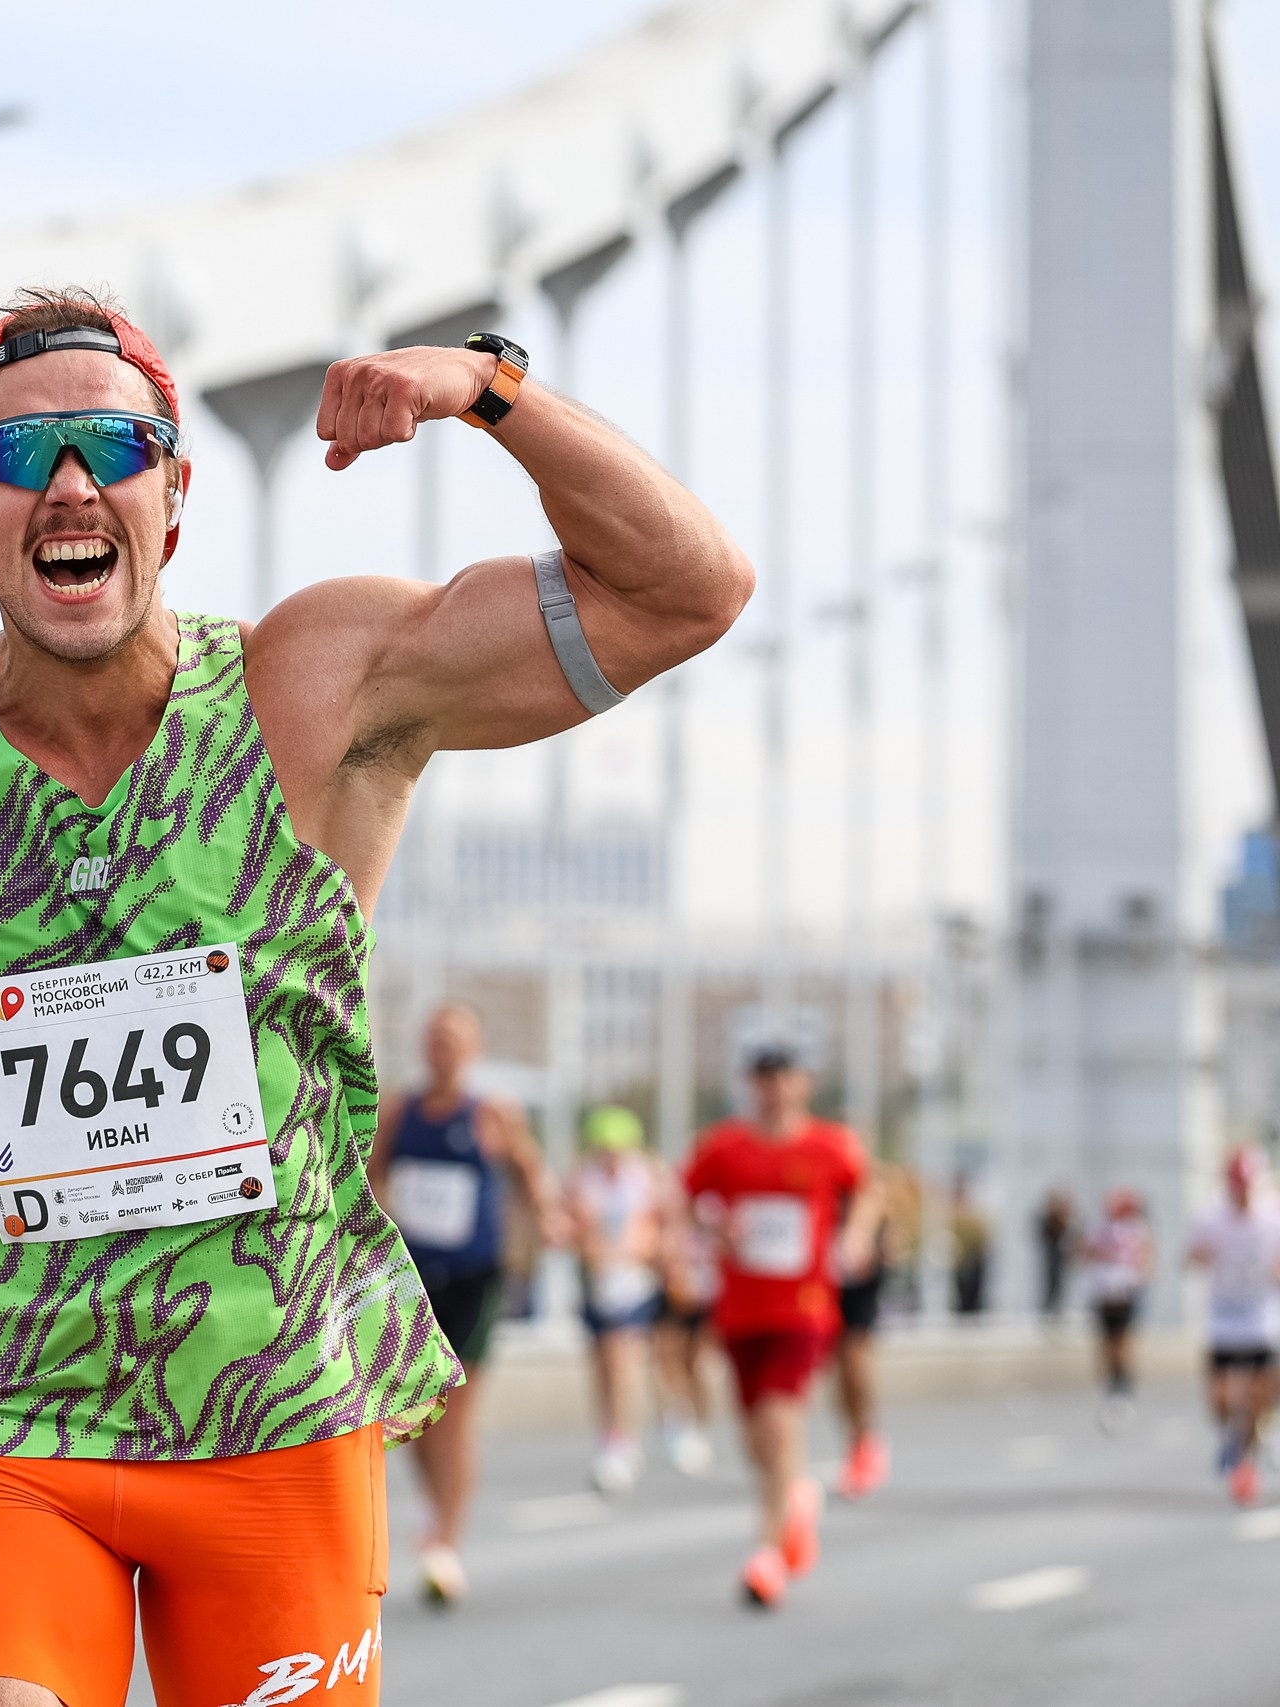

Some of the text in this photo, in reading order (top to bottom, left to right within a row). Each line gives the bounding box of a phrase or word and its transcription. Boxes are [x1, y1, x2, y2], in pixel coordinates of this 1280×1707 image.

[143, 960, 201, 980] 42,2 КМ
[30, 973, 101, 991] СБЕРПРАЙМ
[32, 978, 129, 1004] МОСКОВСКИЙ
[155, 982, 197, 999] 2026
[34, 997, 105, 1017] МАРАФОН
[0, 1022, 211, 1127] 7649
[232, 1112, 241, 1125] 1
[87, 1123, 150, 1150] ИВАН
[125, 1172, 163, 1186] МОСКОВСКИЙ
[189, 1166, 238, 1181] СБЕР Прайм
[126, 1185, 144, 1195] СПОРТ
[210, 1191, 237, 1202] WINLINE
[13, 1189, 49, 1233] D
